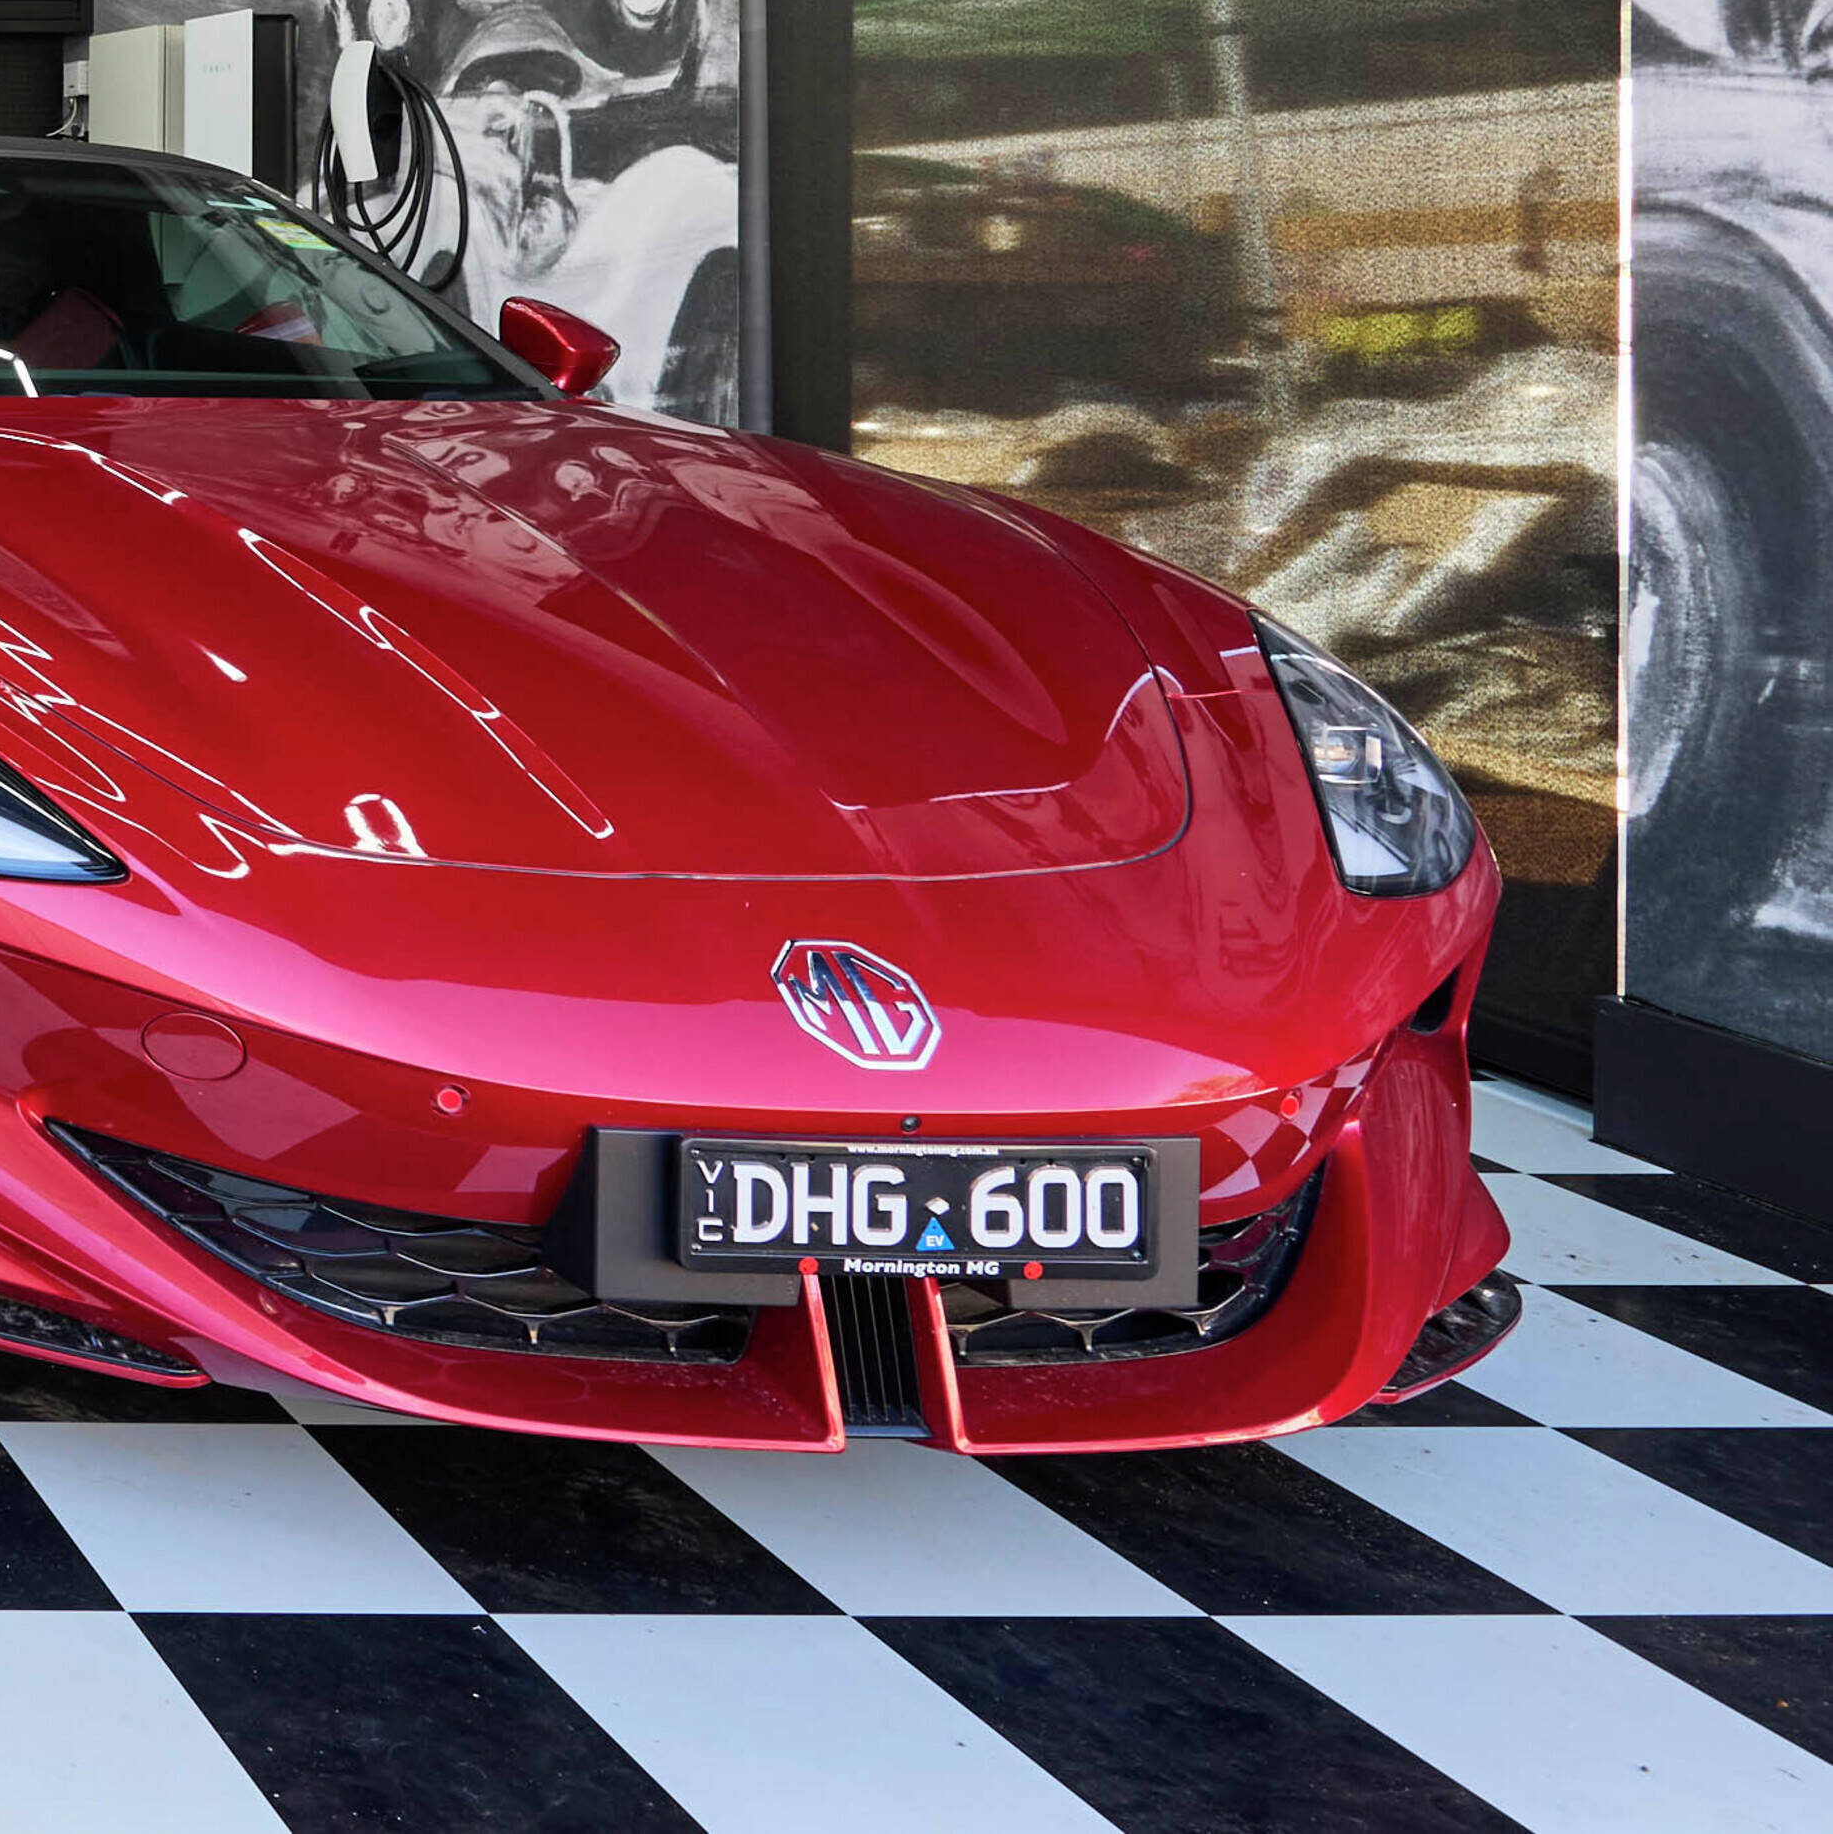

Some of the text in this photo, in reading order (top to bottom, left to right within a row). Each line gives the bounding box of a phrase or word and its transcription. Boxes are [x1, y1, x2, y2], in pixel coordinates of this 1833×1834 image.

[787, 950, 926, 1055] MG
[696, 1160, 724, 1242] VIC
[731, 1161, 1139, 1249] DHG 600
[926, 1235, 944, 1247] EV
[843, 1258, 1000, 1278] Mornington MG
